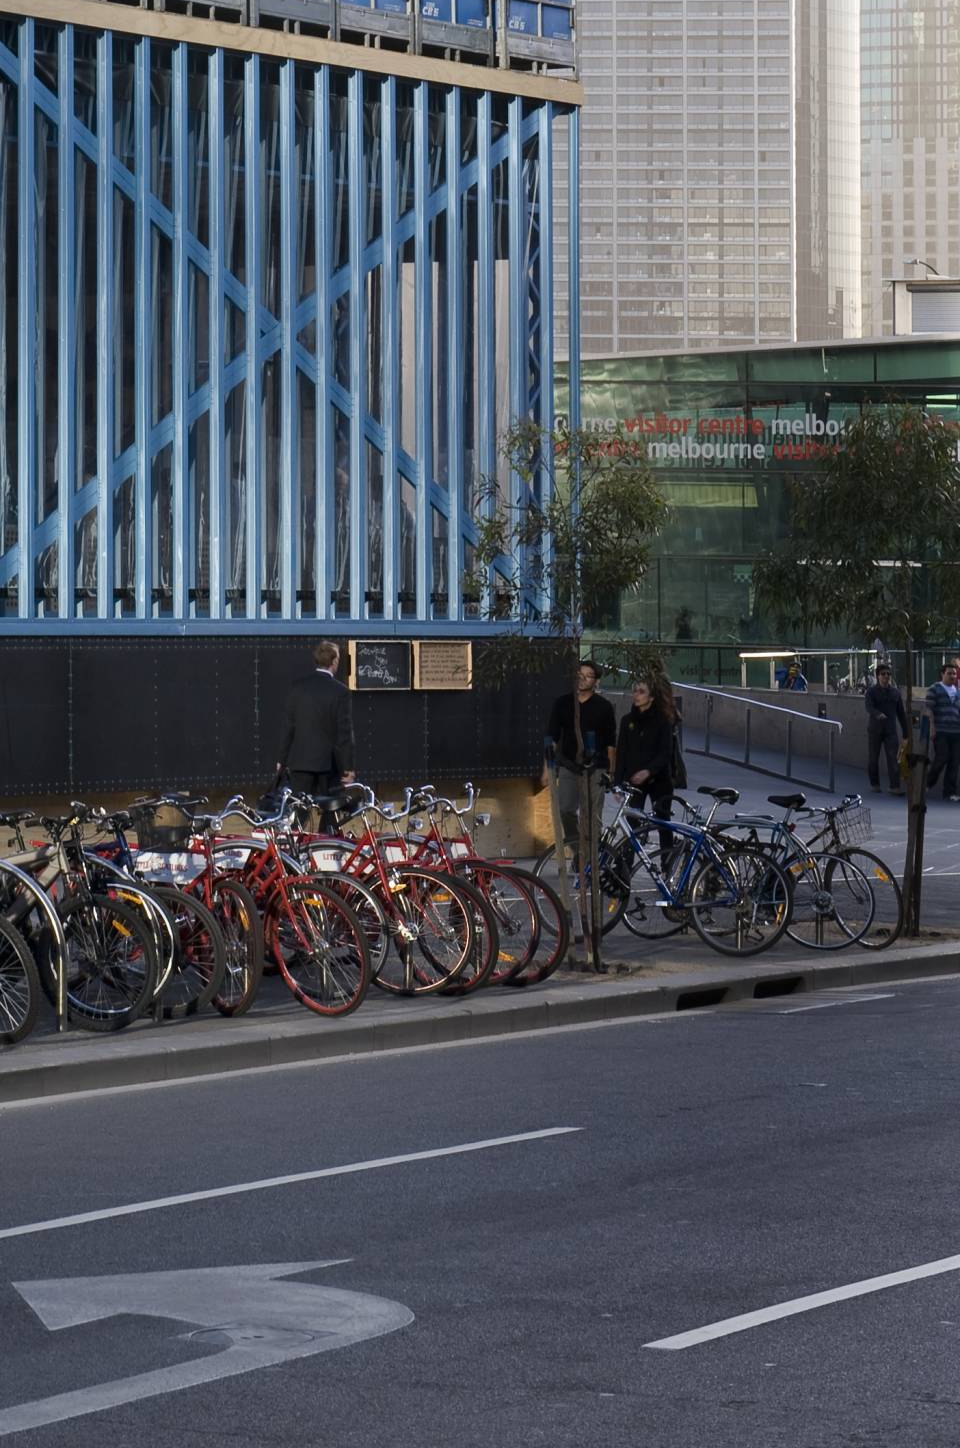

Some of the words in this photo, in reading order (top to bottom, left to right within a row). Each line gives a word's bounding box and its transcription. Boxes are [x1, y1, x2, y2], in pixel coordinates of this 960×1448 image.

[623, 410, 692, 434] visitor
[698, 413, 765, 436] centre
[647, 436, 765, 460] melbourne
